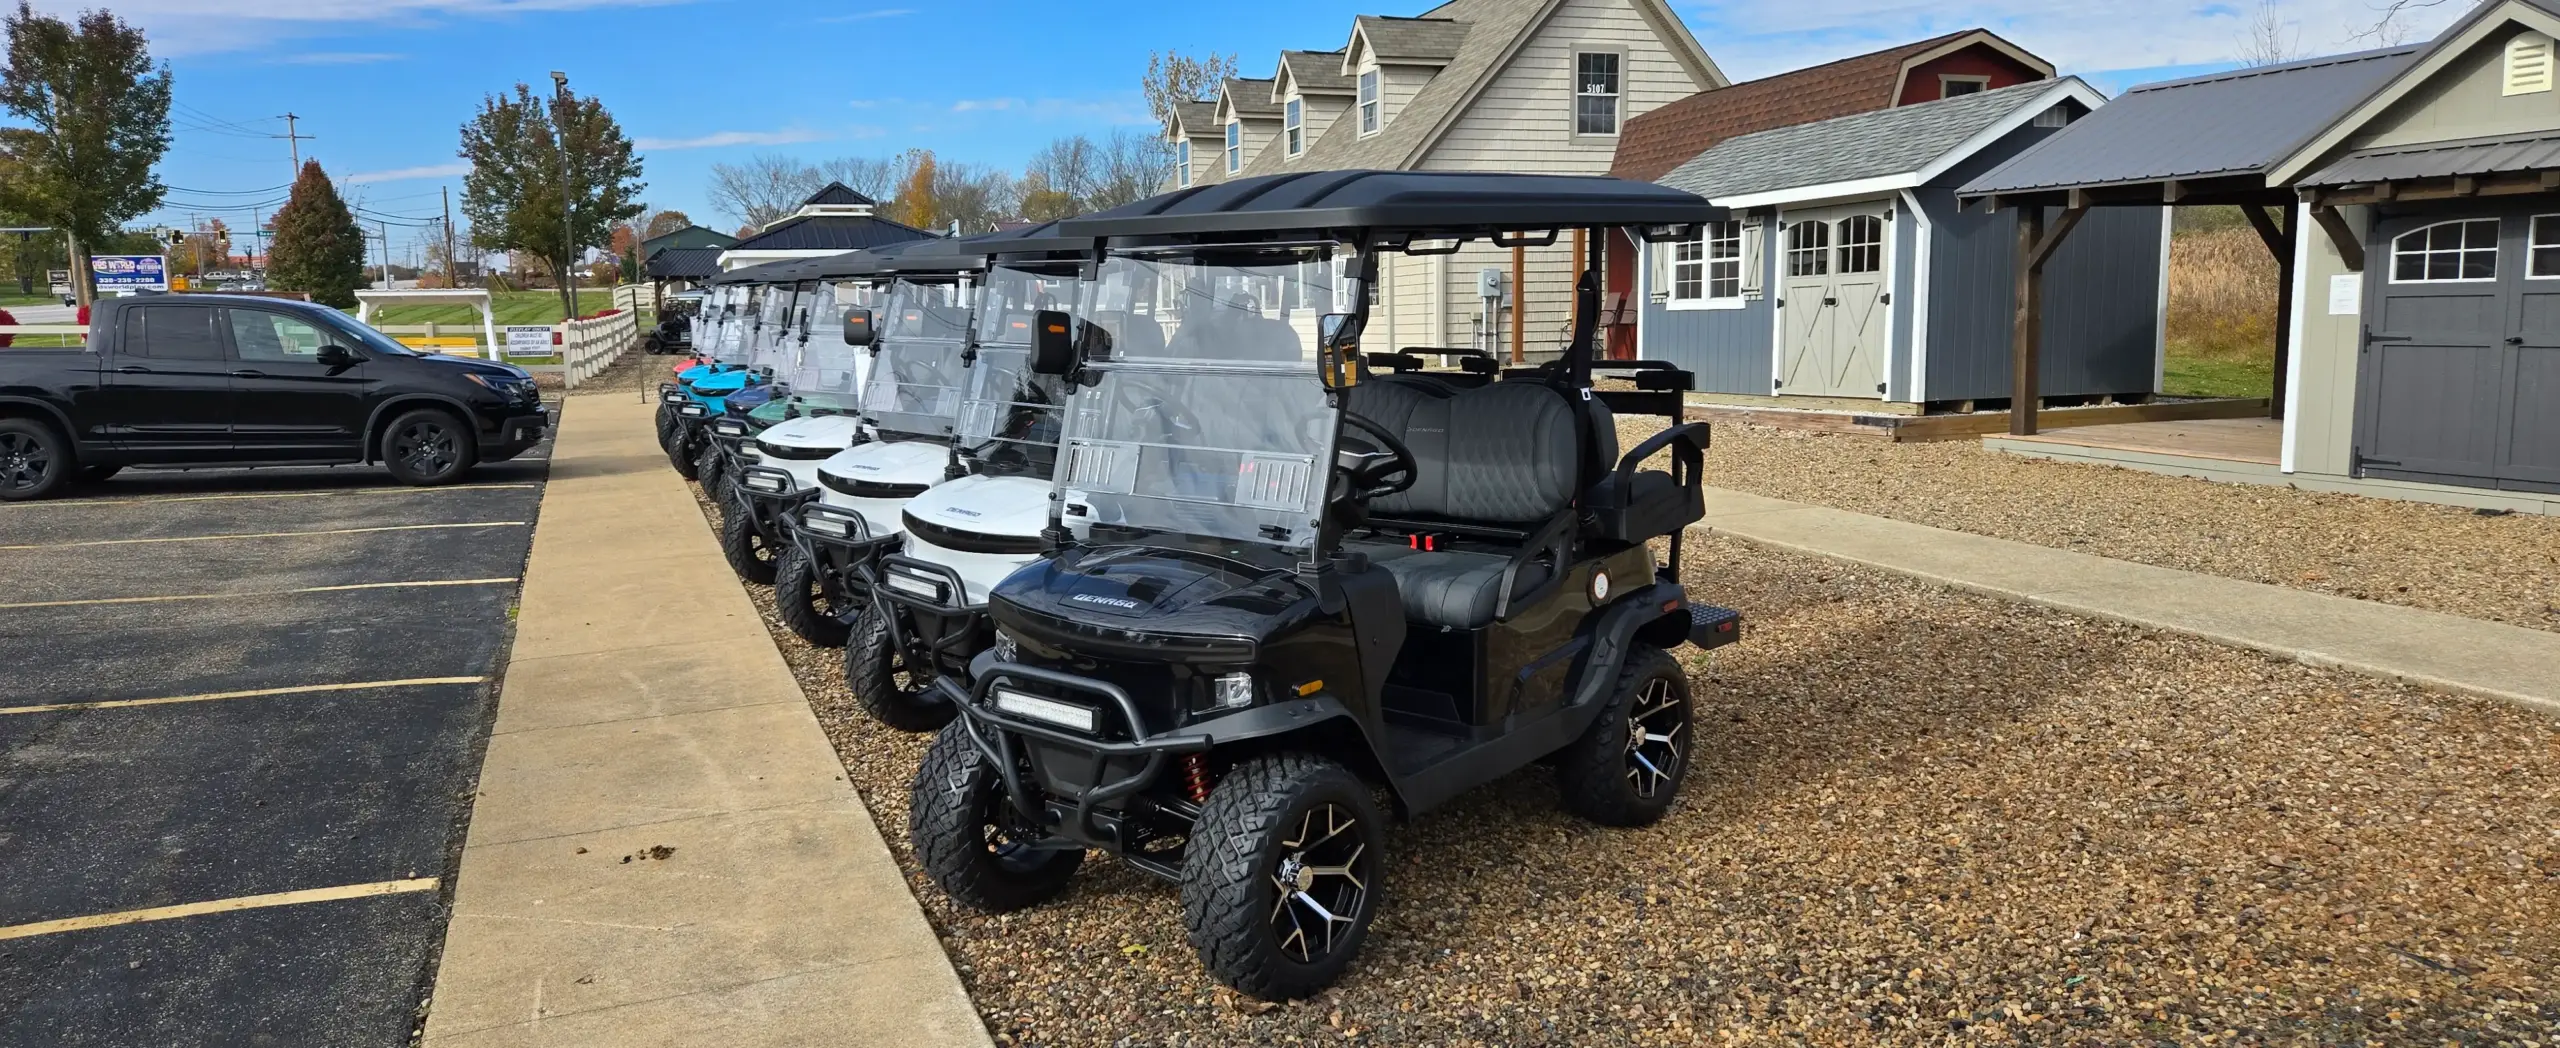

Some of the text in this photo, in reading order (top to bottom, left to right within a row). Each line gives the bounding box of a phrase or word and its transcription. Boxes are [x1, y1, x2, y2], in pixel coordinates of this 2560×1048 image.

[1586, 83, 1605, 94] 5107
[108, 260, 135, 270] WORLD
[1072, 593, 1139, 609] DENAGO
